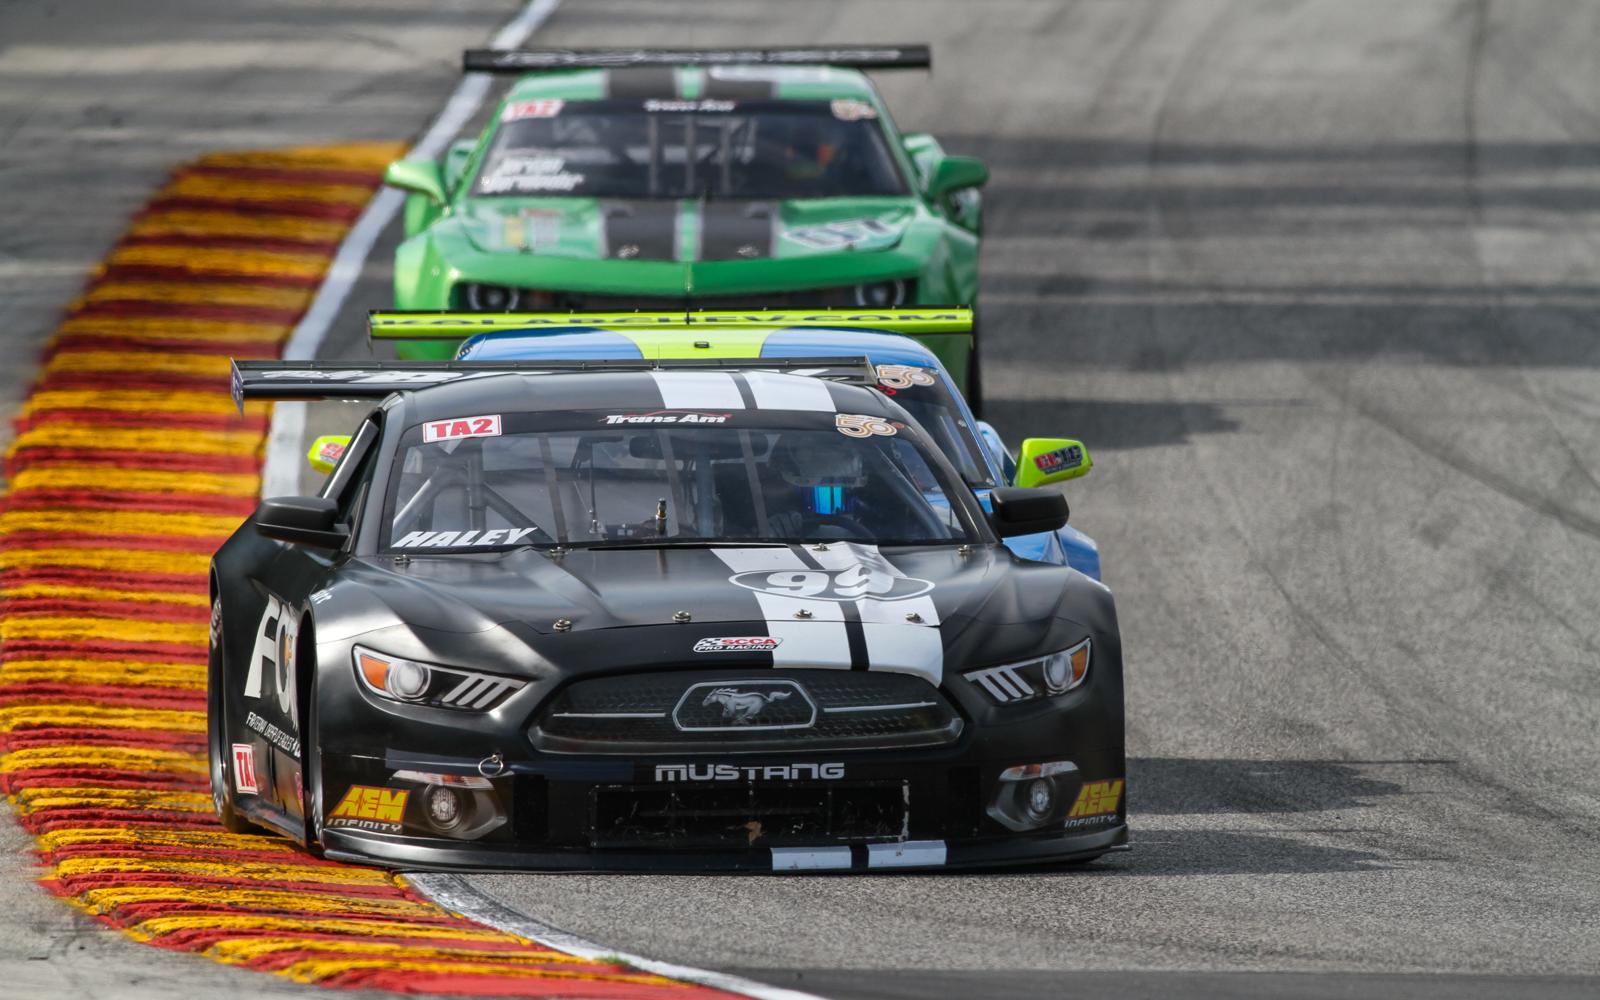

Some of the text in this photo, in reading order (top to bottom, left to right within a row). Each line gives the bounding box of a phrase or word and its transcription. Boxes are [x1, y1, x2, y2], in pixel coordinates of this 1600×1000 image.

[431, 418, 493, 438] TA2
[606, 414, 726, 424] Trans Am
[391, 527, 537, 548] HALEY
[766, 564, 894, 597] 99
[655, 763, 845, 782] MUSTANG
[332, 786, 407, 821] AEM
[1068, 780, 1123, 816] AEM
[327, 818, 403, 832] INFINITY
[1064, 815, 1117, 828] INFINITY
